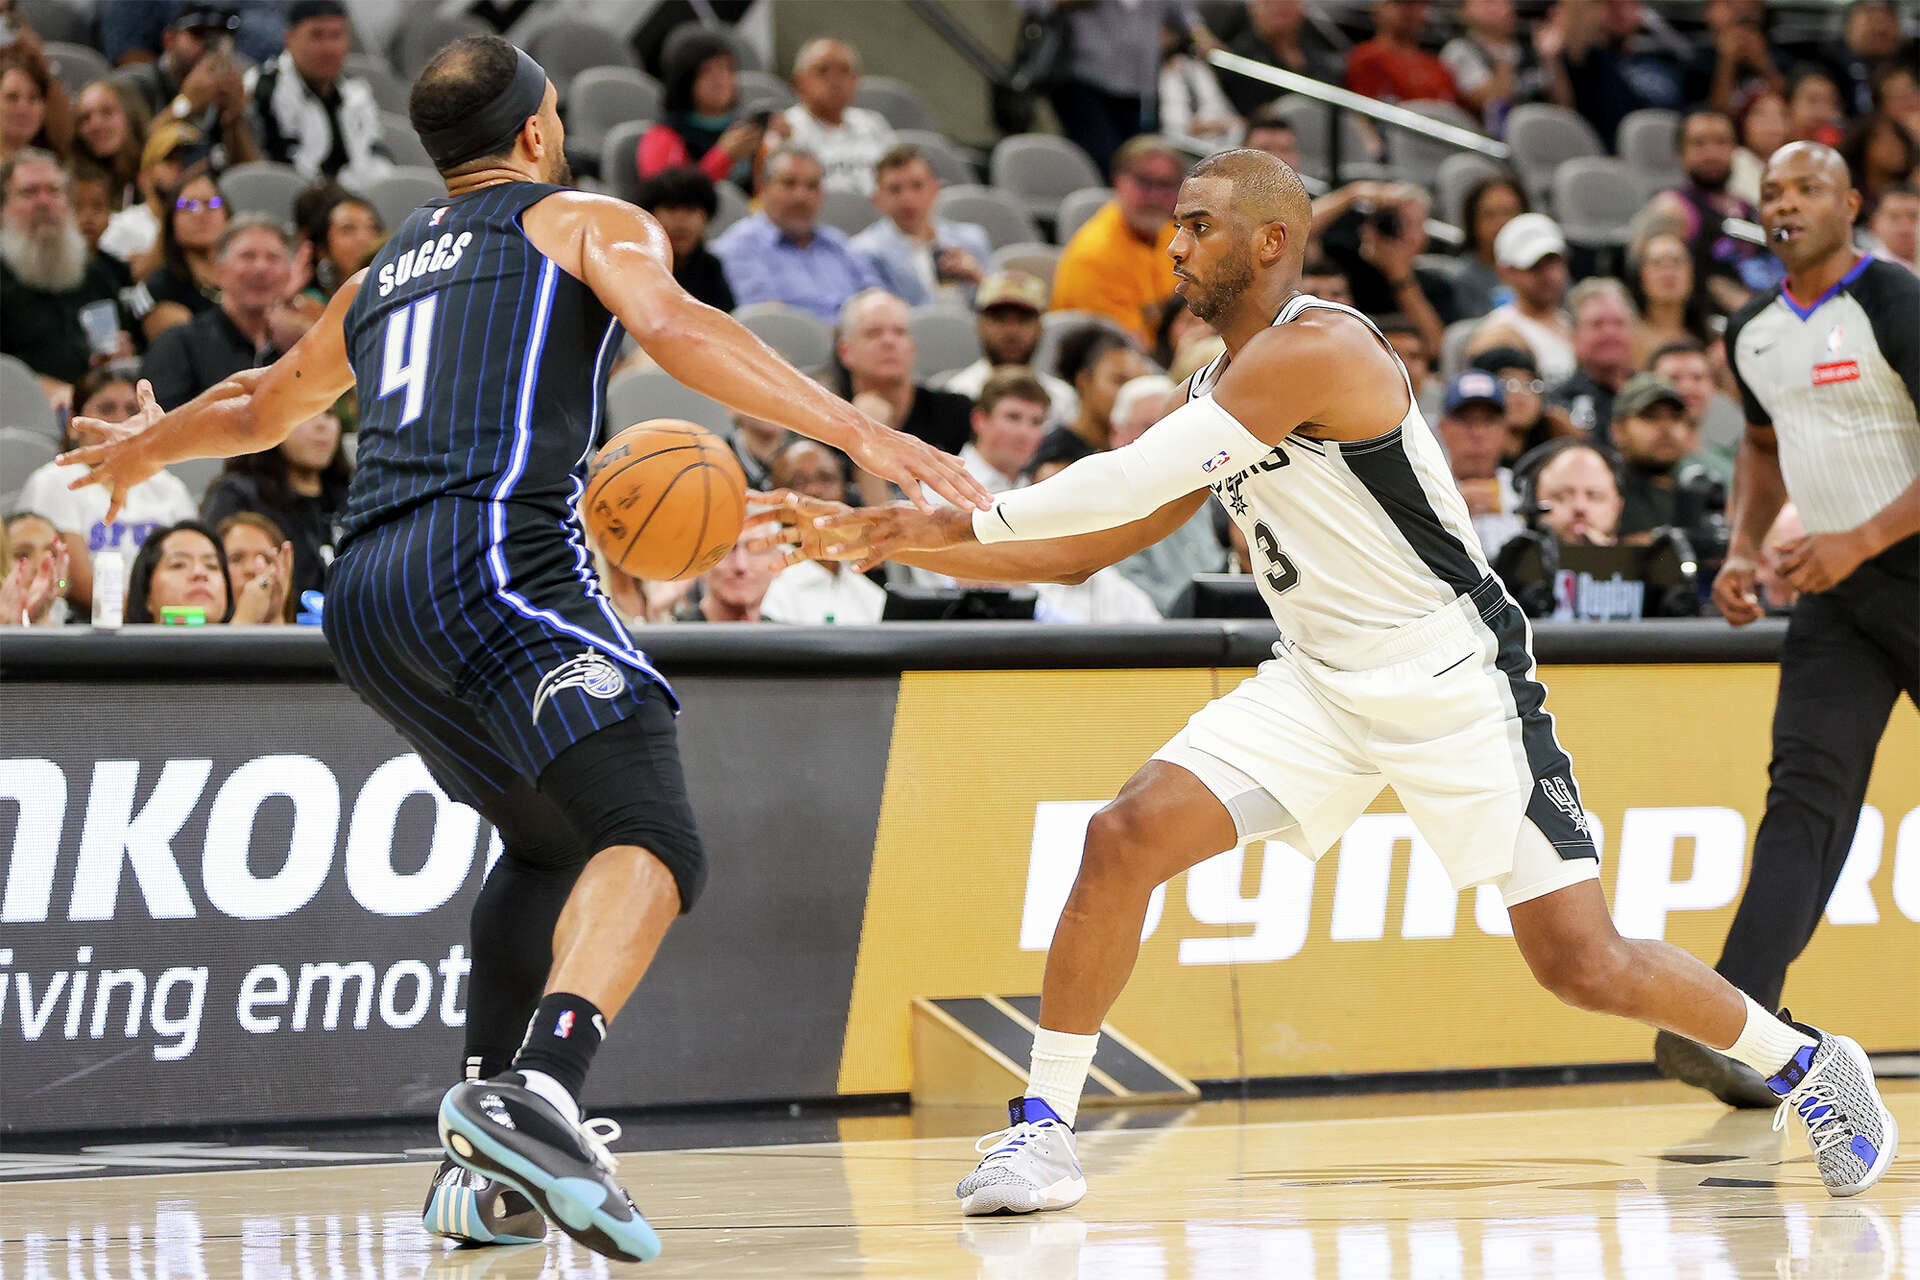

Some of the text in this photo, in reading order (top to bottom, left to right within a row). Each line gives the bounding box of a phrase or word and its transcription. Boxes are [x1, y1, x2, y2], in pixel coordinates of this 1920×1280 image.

[378, 230, 473, 297] SUGGS
[377, 290, 439, 430] 4
[1254, 518, 1301, 596] 3
[236, 944, 472, 1034] emot
